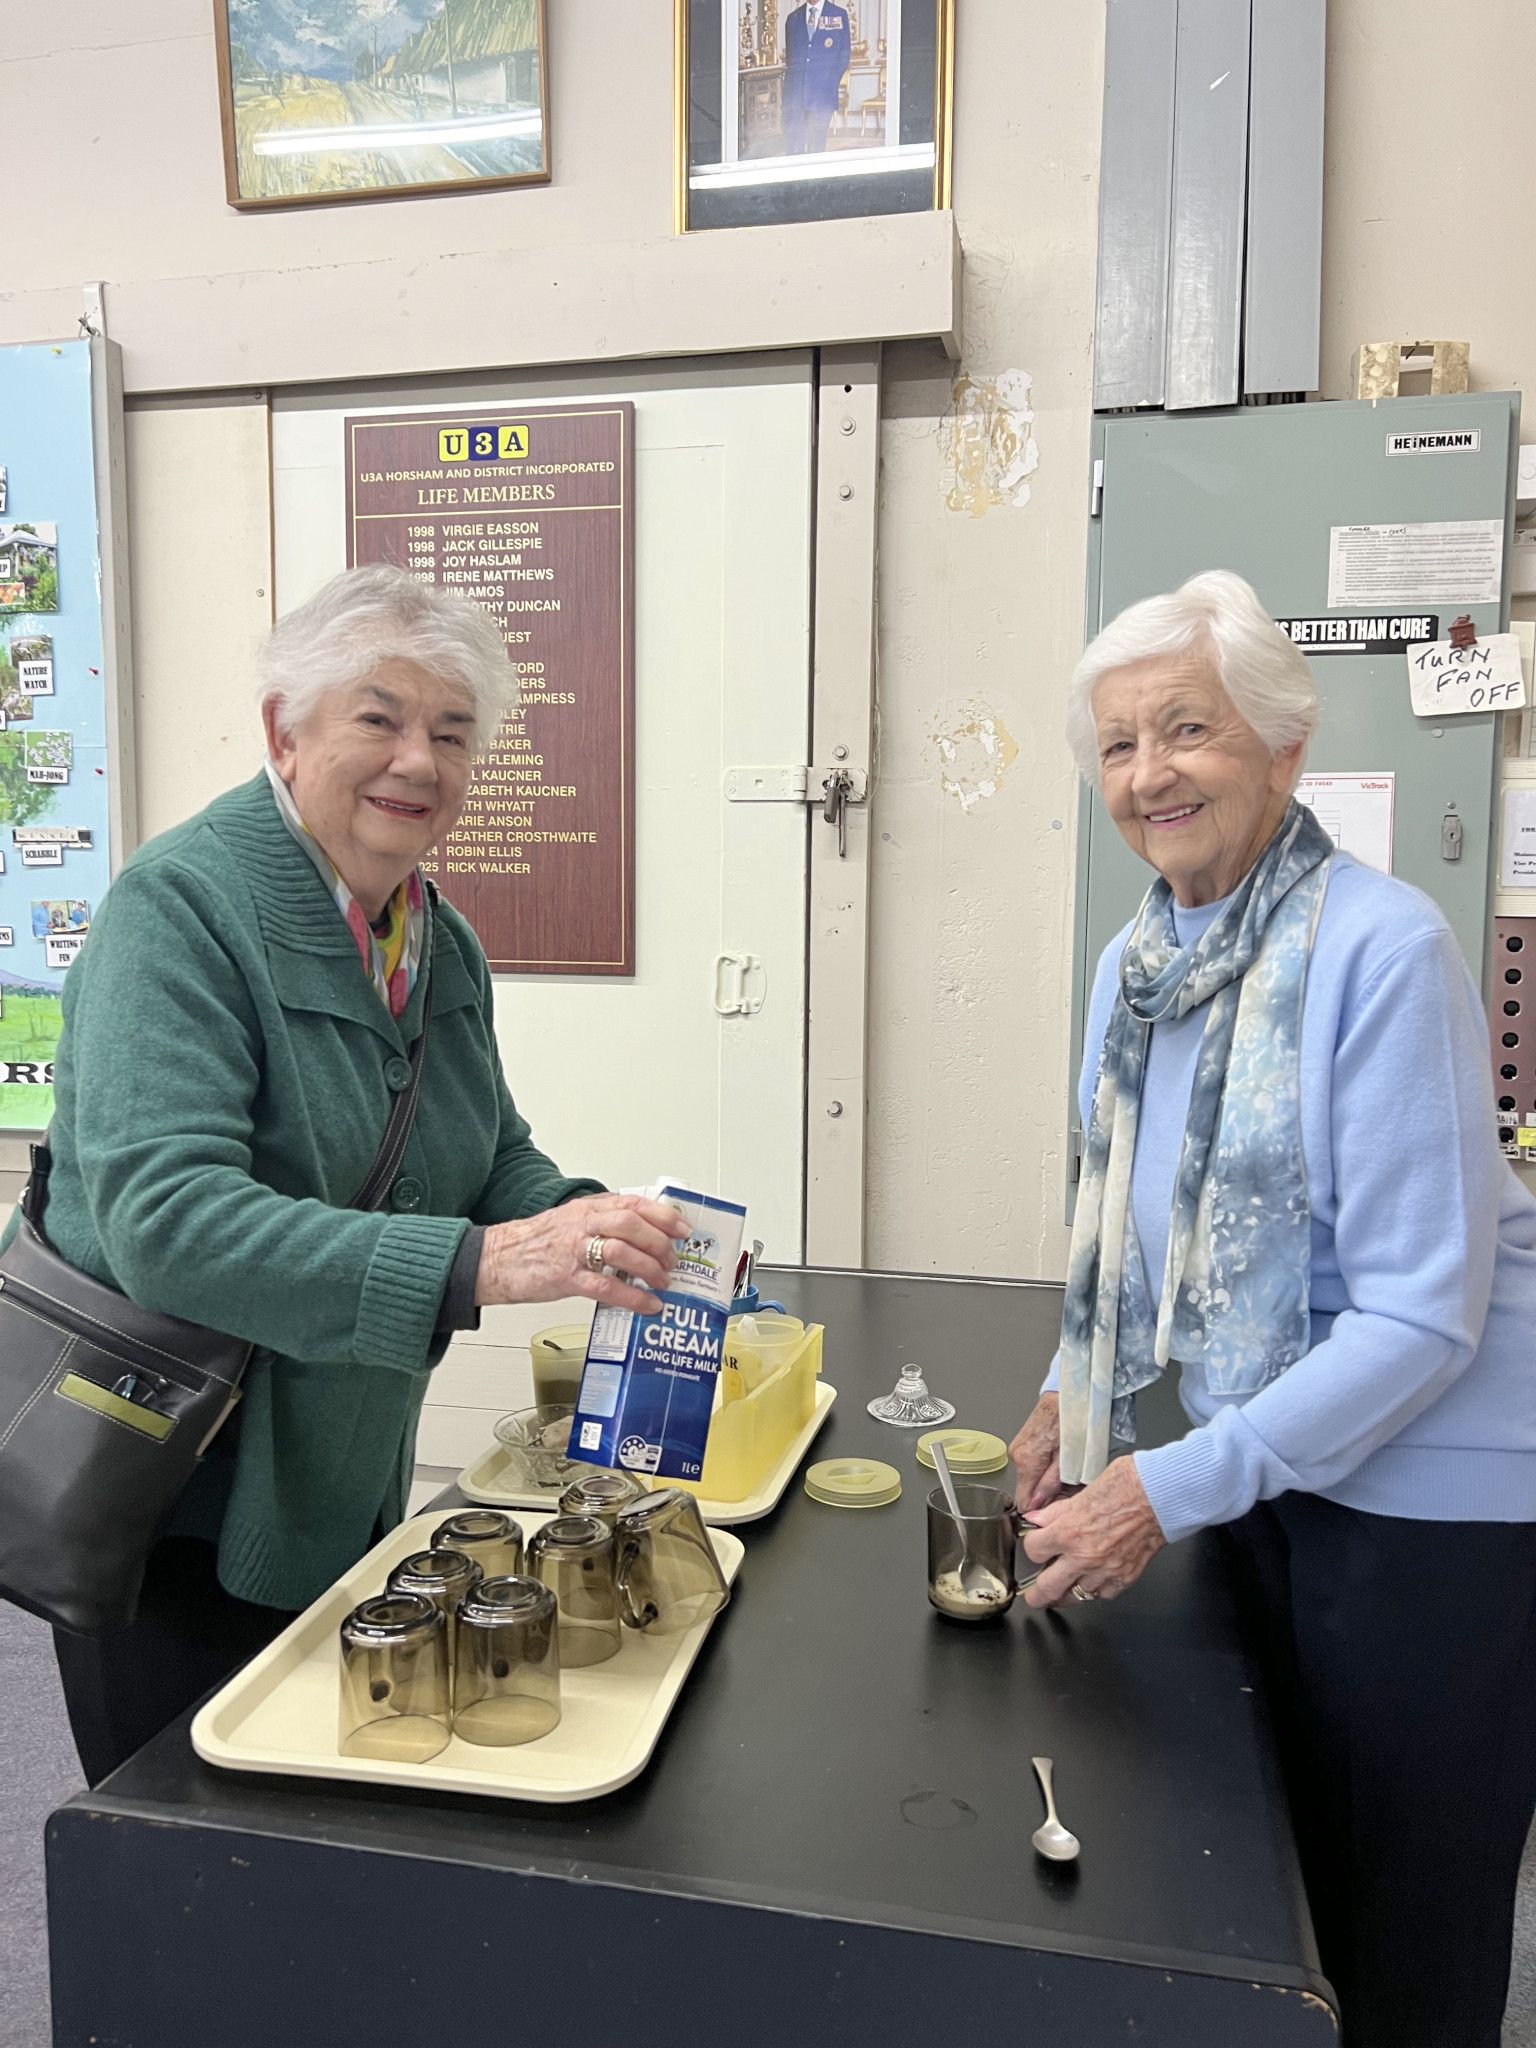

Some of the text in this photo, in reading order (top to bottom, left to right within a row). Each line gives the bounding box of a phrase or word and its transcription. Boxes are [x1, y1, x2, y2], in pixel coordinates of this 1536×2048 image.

[443, 431, 525, 456] U3A
[360, 461, 615, 483] U3A HORSHAM AND DISTRICT INCORPORATED
[417, 484, 556, 505] LIFE MEMBERS
[407, 522, 539, 537] 1998 VIRGIE EASSON
[407, 537, 543, 553] 1998 JACK GILLESPIE
[407, 554, 522, 568] 1998 JOY HASLAM
[442, 570, 480, 583] IRENE
[483, 568, 555, 582] MATTHEWS
[467, 585, 505, 598] AMOS
[507, 599, 561, 612] DUNCAN
[1291, 620, 1347, 642] BETTER
[1349, 618, 1388, 640] THAN
[1389, 617, 1431, 640] CURE
[1415, 647, 1490, 670] TURN
[23, 666, 48, 676] NATURE
[24, 680, 48, 689] WATCH
[1437, 668, 1492, 692] FAN
[1470, 681, 1520, 708] OFF
[489, 739, 532, 750] BAKER
[488, 754, 544, 766] FLEMING
[482, 770, 542, 781] KAUCNER
[467, 785, 577, 797] ZABETH KAUCNER
[485, 801, 536, 812] WHYATT
[456, 816, 532, 827] ARIE ANSON
[446, 831, 598, 843] HEATHER CROSTHWAITE
[446, 846, 485, 858] ROBIN
[488, 847, 523, 858] ELLIS
[446, 862, 476, 873] RICK
[479, 863, 531, 874] WALKER
[50, 939, 78, 949] WRITING
[58, 953, 71, 962] FUN
[675, 1260, 719, 1281] ARMDALE
[661, 1303, 711, 1333] FULL
[644, 1323, 719, 1359] CREAM
[638, 1346, 670, 1364] LONG
[671, 1353, 694, 1368] LIFE
[693, 1359, 719, 1373] MILK
